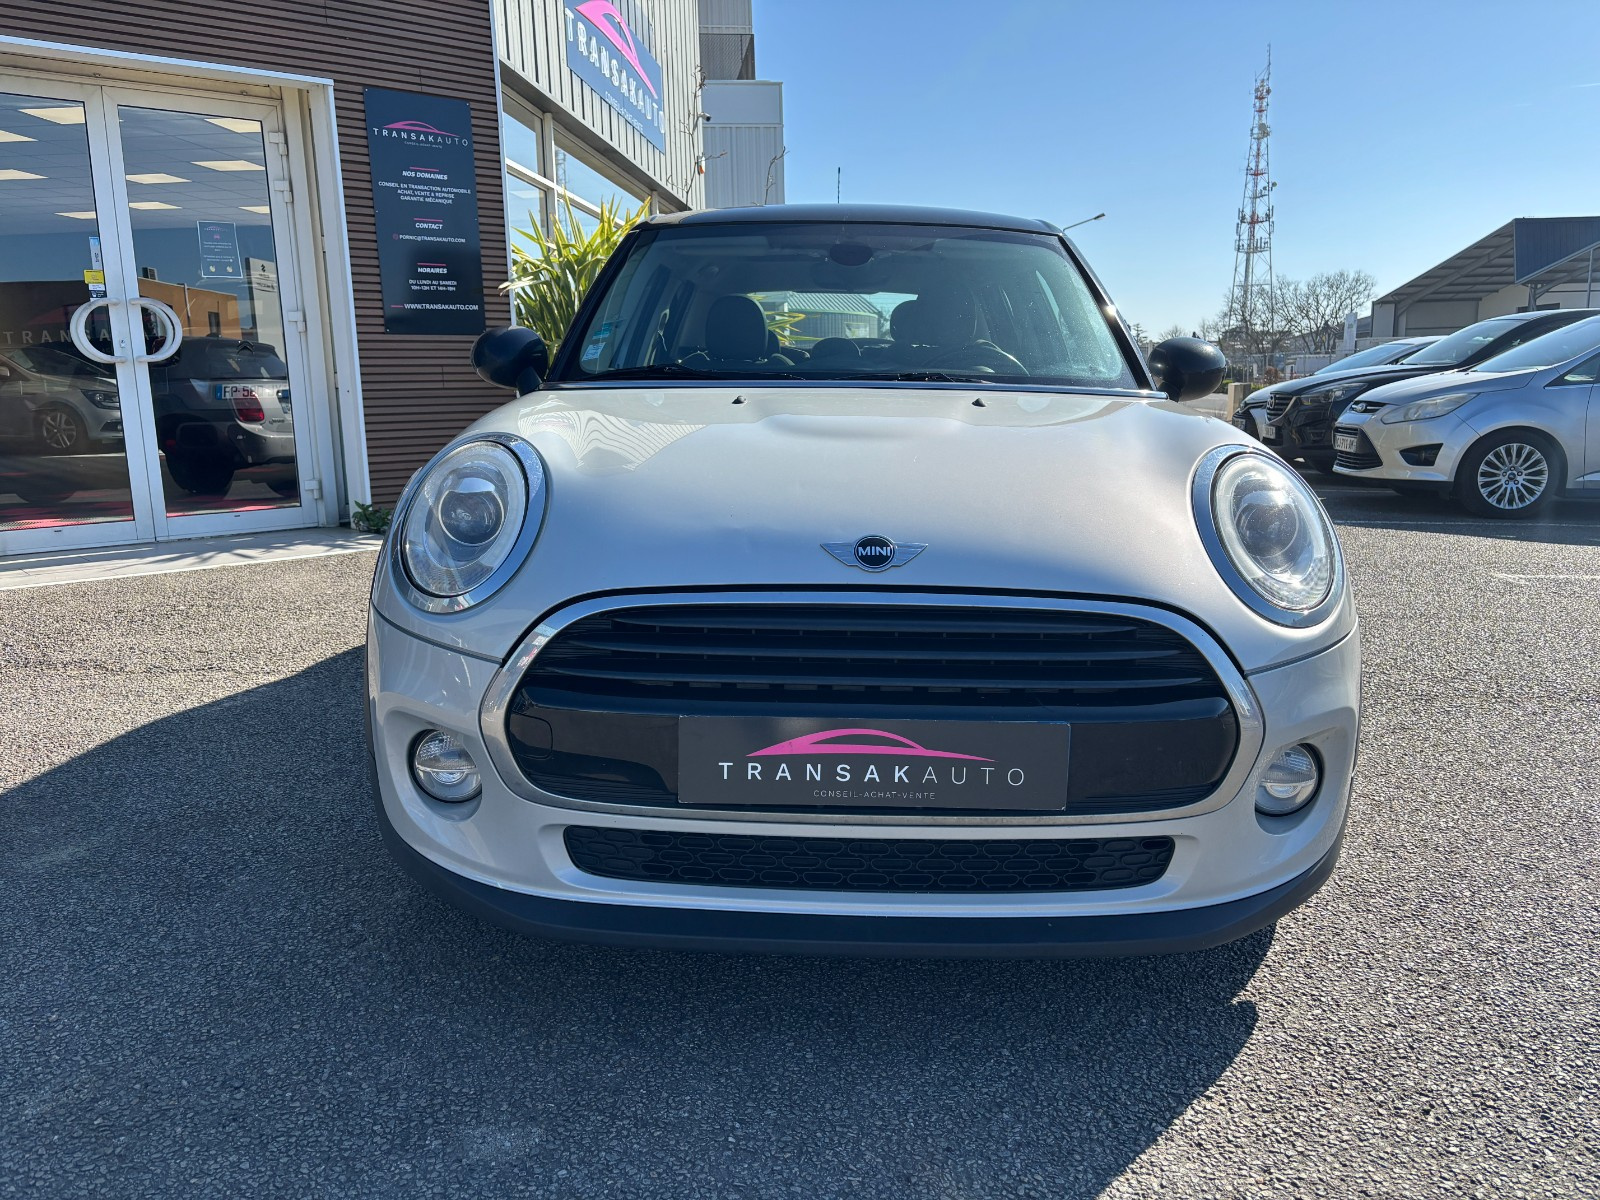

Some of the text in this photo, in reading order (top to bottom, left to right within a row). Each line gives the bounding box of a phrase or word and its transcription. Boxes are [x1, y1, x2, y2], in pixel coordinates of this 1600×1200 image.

[564, 8, 665, 134] TRANSAKAUTO
[372, 127, 469, 147] TRANSAKAUTO
[402, 170, 448, 180] NOS DOMAINES
[408, 184, 441, 192] TRANSACTION
[415, 222, 443, 230] CONTACT
[399, 234, 466, 243] PORNIC@TRANSAKAUTO.COM
[403, 303, 479, 311] WWW.TRANSAKAUTO.COM
[857, 545, 892, 558] MINI
[718, 762, 1025, 787] TRANSAKAUTO
[813, 789, 936, 800] CONSEIL-ACHAT-VENTE
